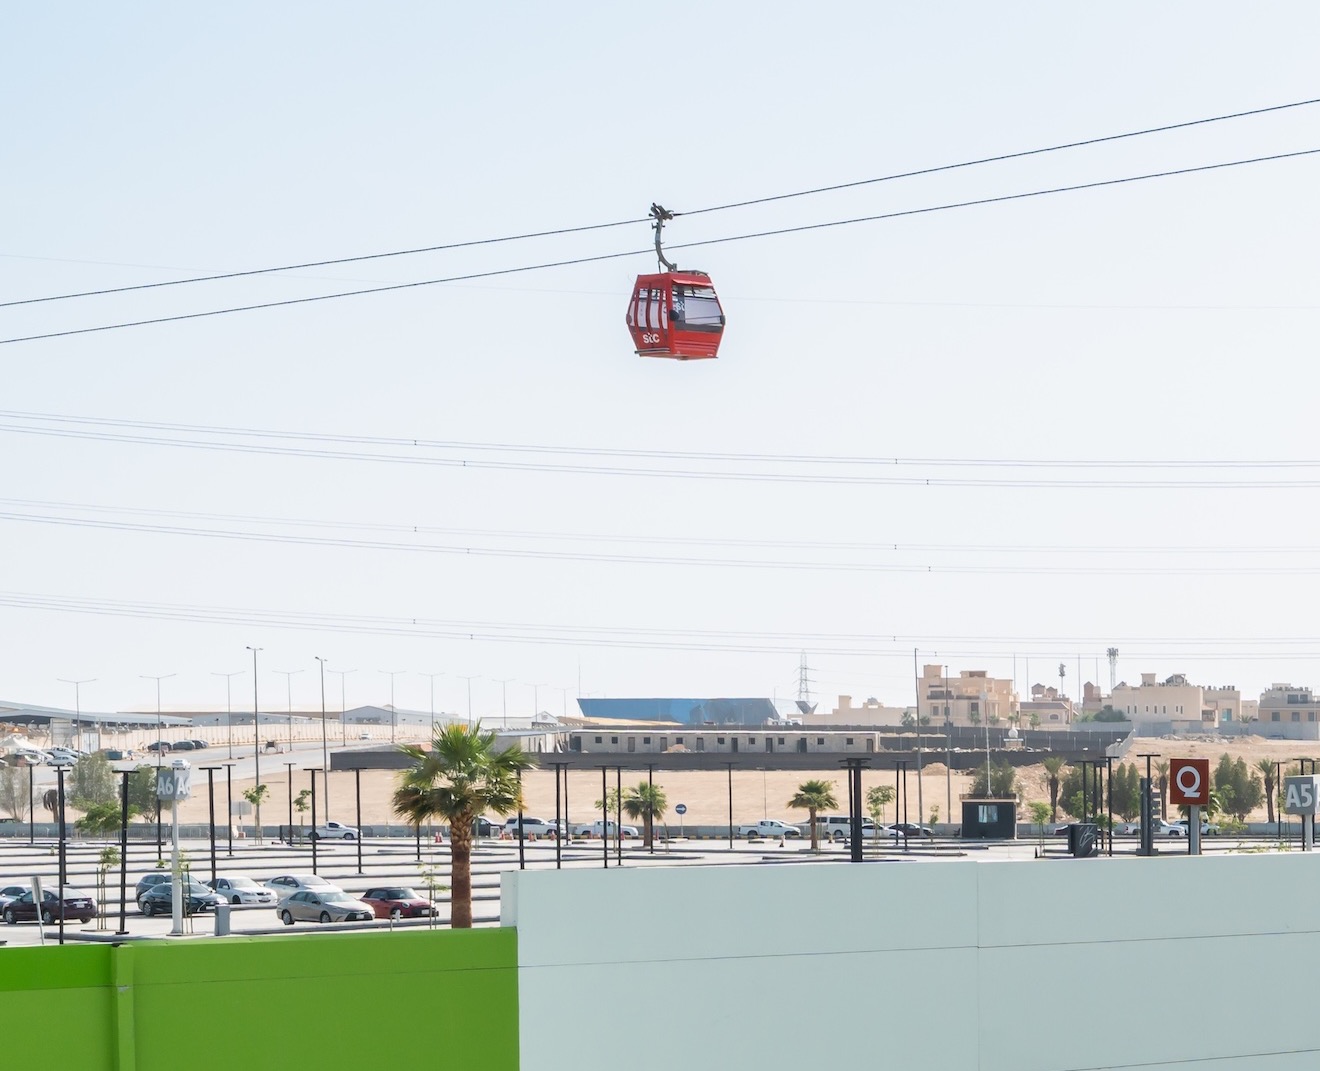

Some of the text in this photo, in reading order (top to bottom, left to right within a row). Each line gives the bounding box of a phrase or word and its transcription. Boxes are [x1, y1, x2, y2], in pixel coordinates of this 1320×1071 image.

[643, 333, 660, 343] stc
[157, 777, 173, 795] A6
[1176, 766, 1200, 797] Q
[1286, 784, 1313, 807] A5
